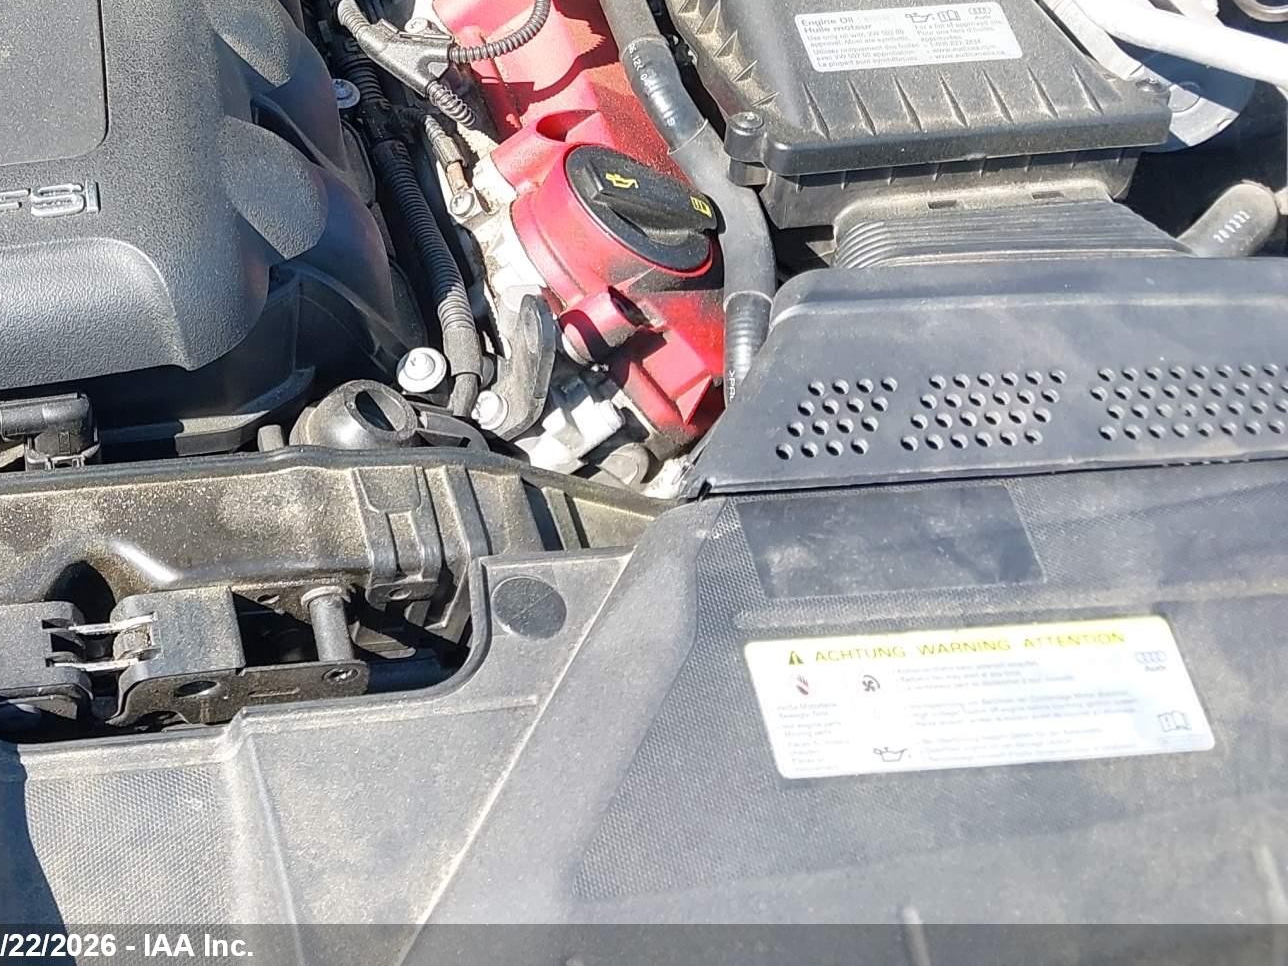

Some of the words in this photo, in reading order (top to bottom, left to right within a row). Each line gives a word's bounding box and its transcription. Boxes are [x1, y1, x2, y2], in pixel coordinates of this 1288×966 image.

[801, 18, 836, 28] Engine
[804, 25, 830, 33] Huile
[833, 24, 872, 32] moteur
[815, 646, 906, 662] ACHTUNG
[919, 639, 1010, 656] WARNING
[1024, 633, 1125, 648] ATTENTION
